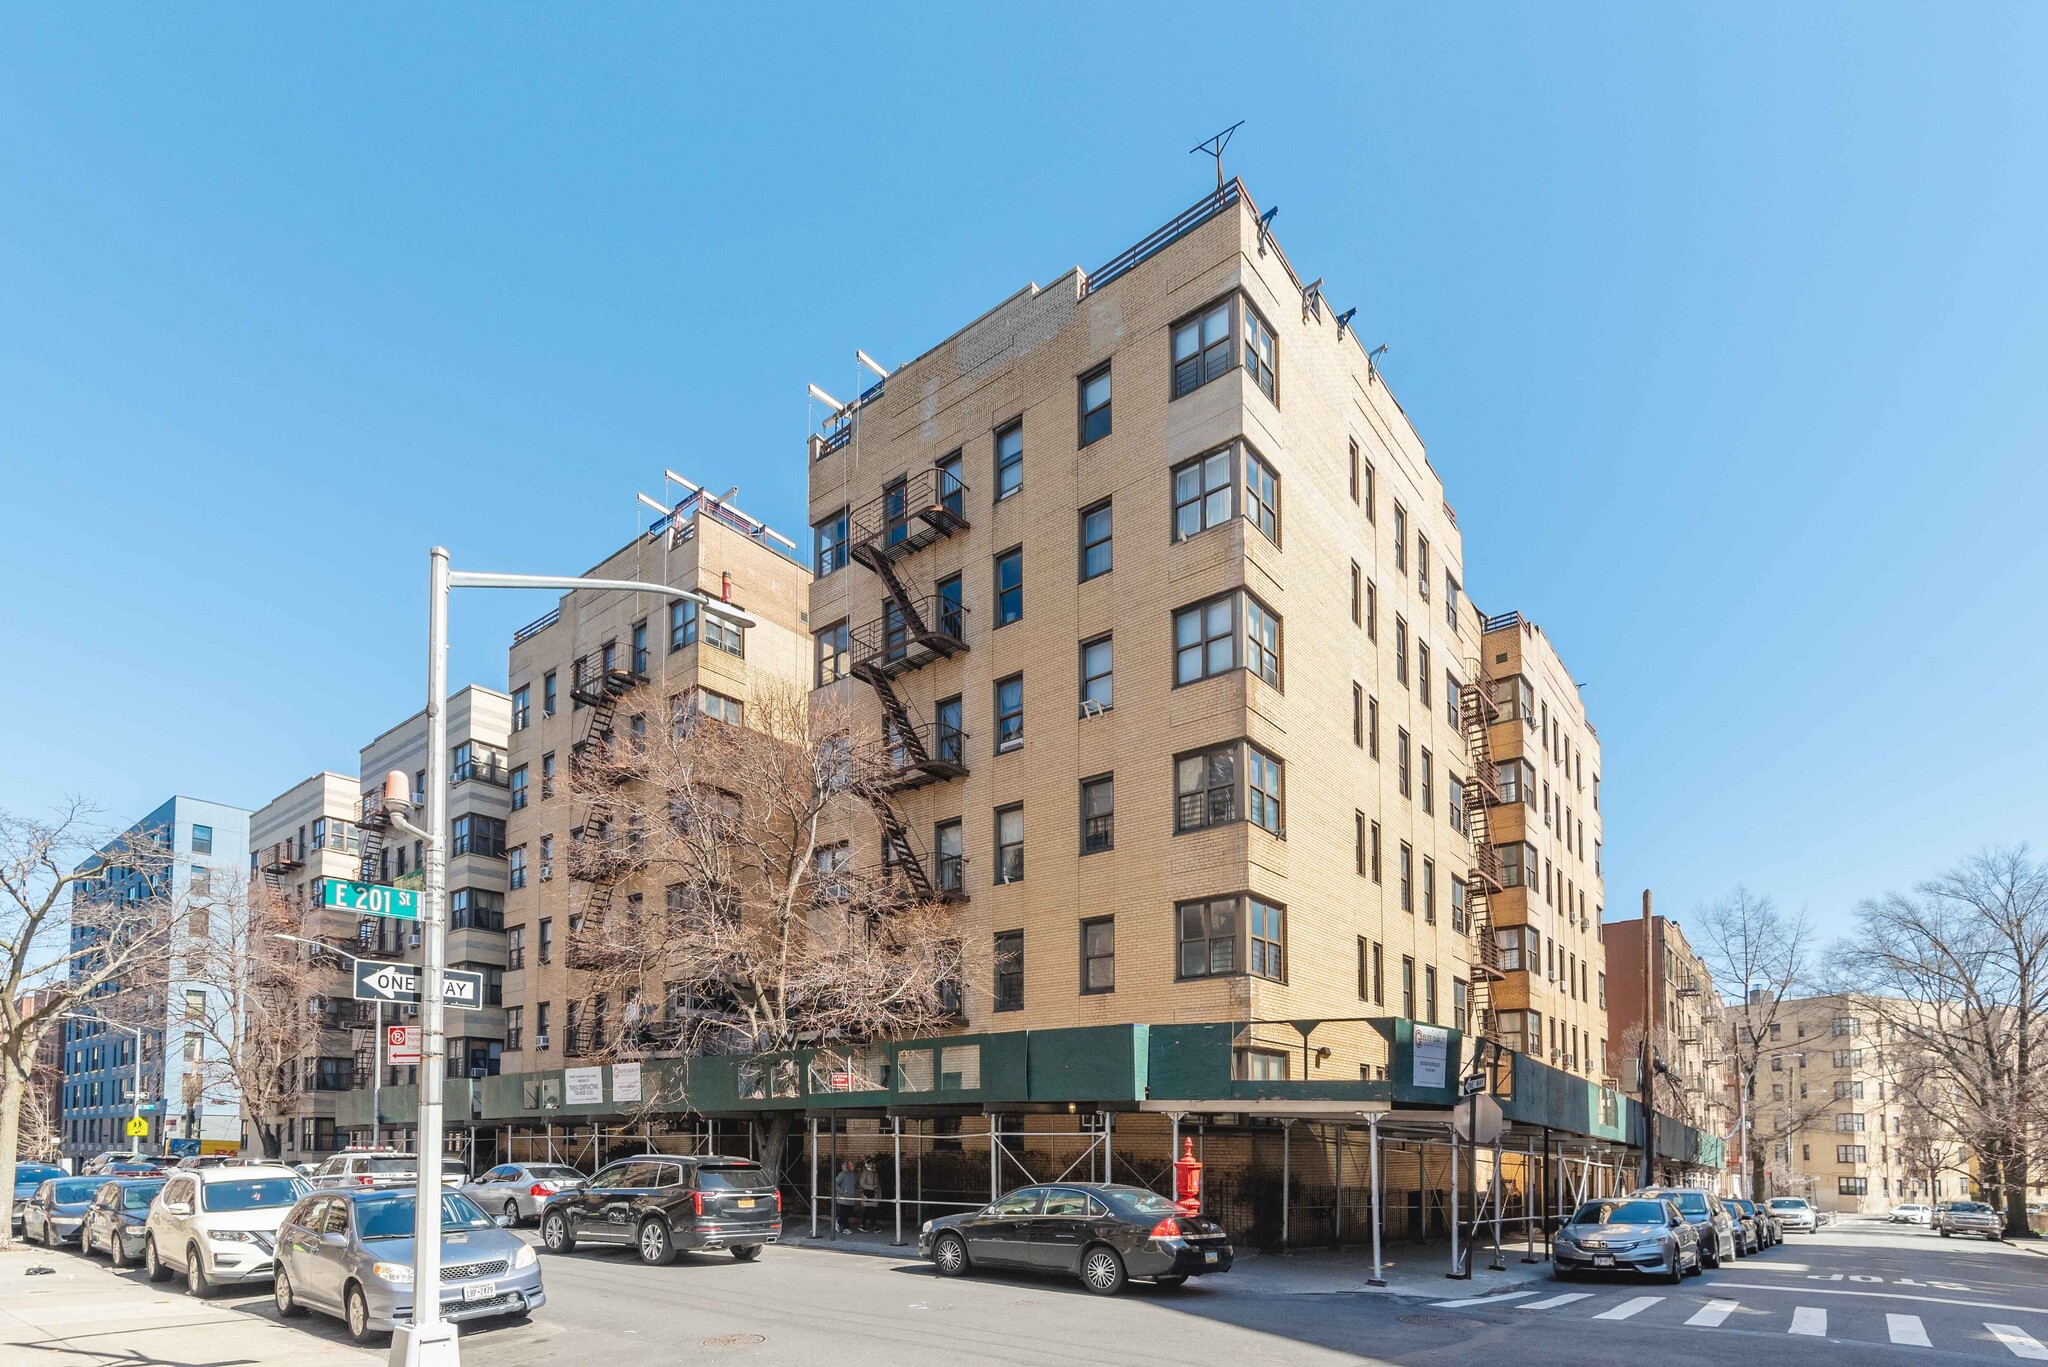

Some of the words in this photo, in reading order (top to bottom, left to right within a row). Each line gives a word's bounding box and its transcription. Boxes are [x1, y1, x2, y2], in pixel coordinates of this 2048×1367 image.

[335, 883, 348, 907] E
[355, 887, 391, 913] 201
[399, 891, 411, 906] St
[377, 975, 415, 991] ONE
[443, 981, 467, 997] AY
[1806, 1273, 1971, 1291] STOP
